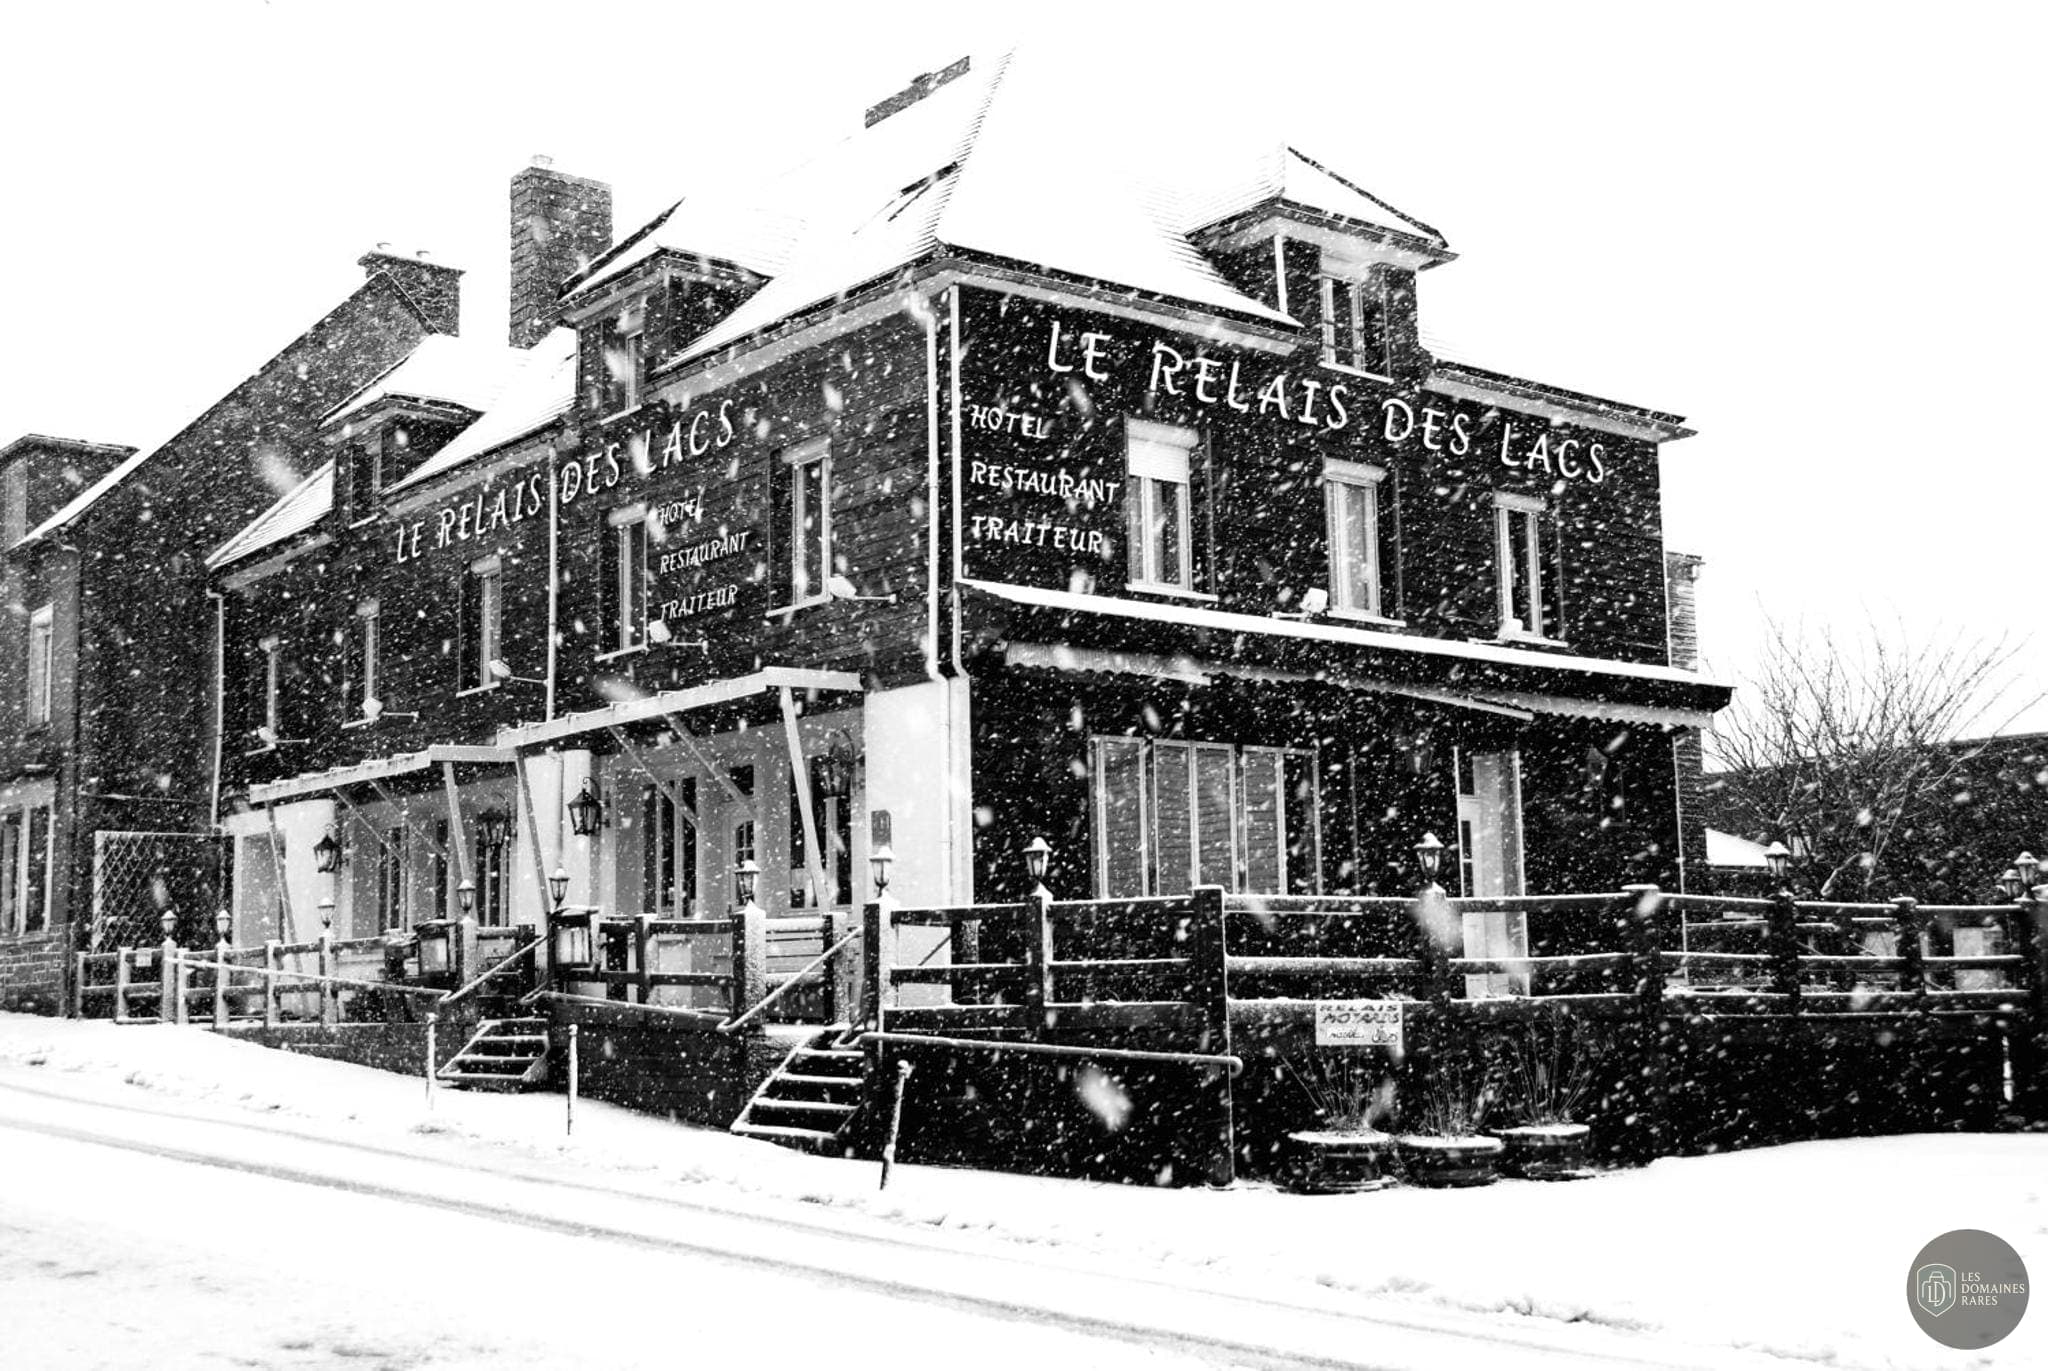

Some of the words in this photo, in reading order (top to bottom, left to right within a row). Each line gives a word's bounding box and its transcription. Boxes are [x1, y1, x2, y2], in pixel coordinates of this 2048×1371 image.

[969, 405, 1051, 440] HOTEL
[1048, 320, 1111, 381] LE
[1150, 341, 1349, 429] RELAIS
[1382, 398, 1472, 456] DES
[1502, 423, 1605, 484] LACS
[397, 522, 425, 563] LE
[437, 474, 542, 549] RELAIS
[561, 442, 620, 504] DES
[644, 399, 734, 474] LACS
[969, 461, 1120, 503] RESTAURANT
[659, 531, 749, 575] RESTAURANT
[970, 515, 1103, 554] TRAITEUR
[659, 585, 738, 621] TRAITEUR
